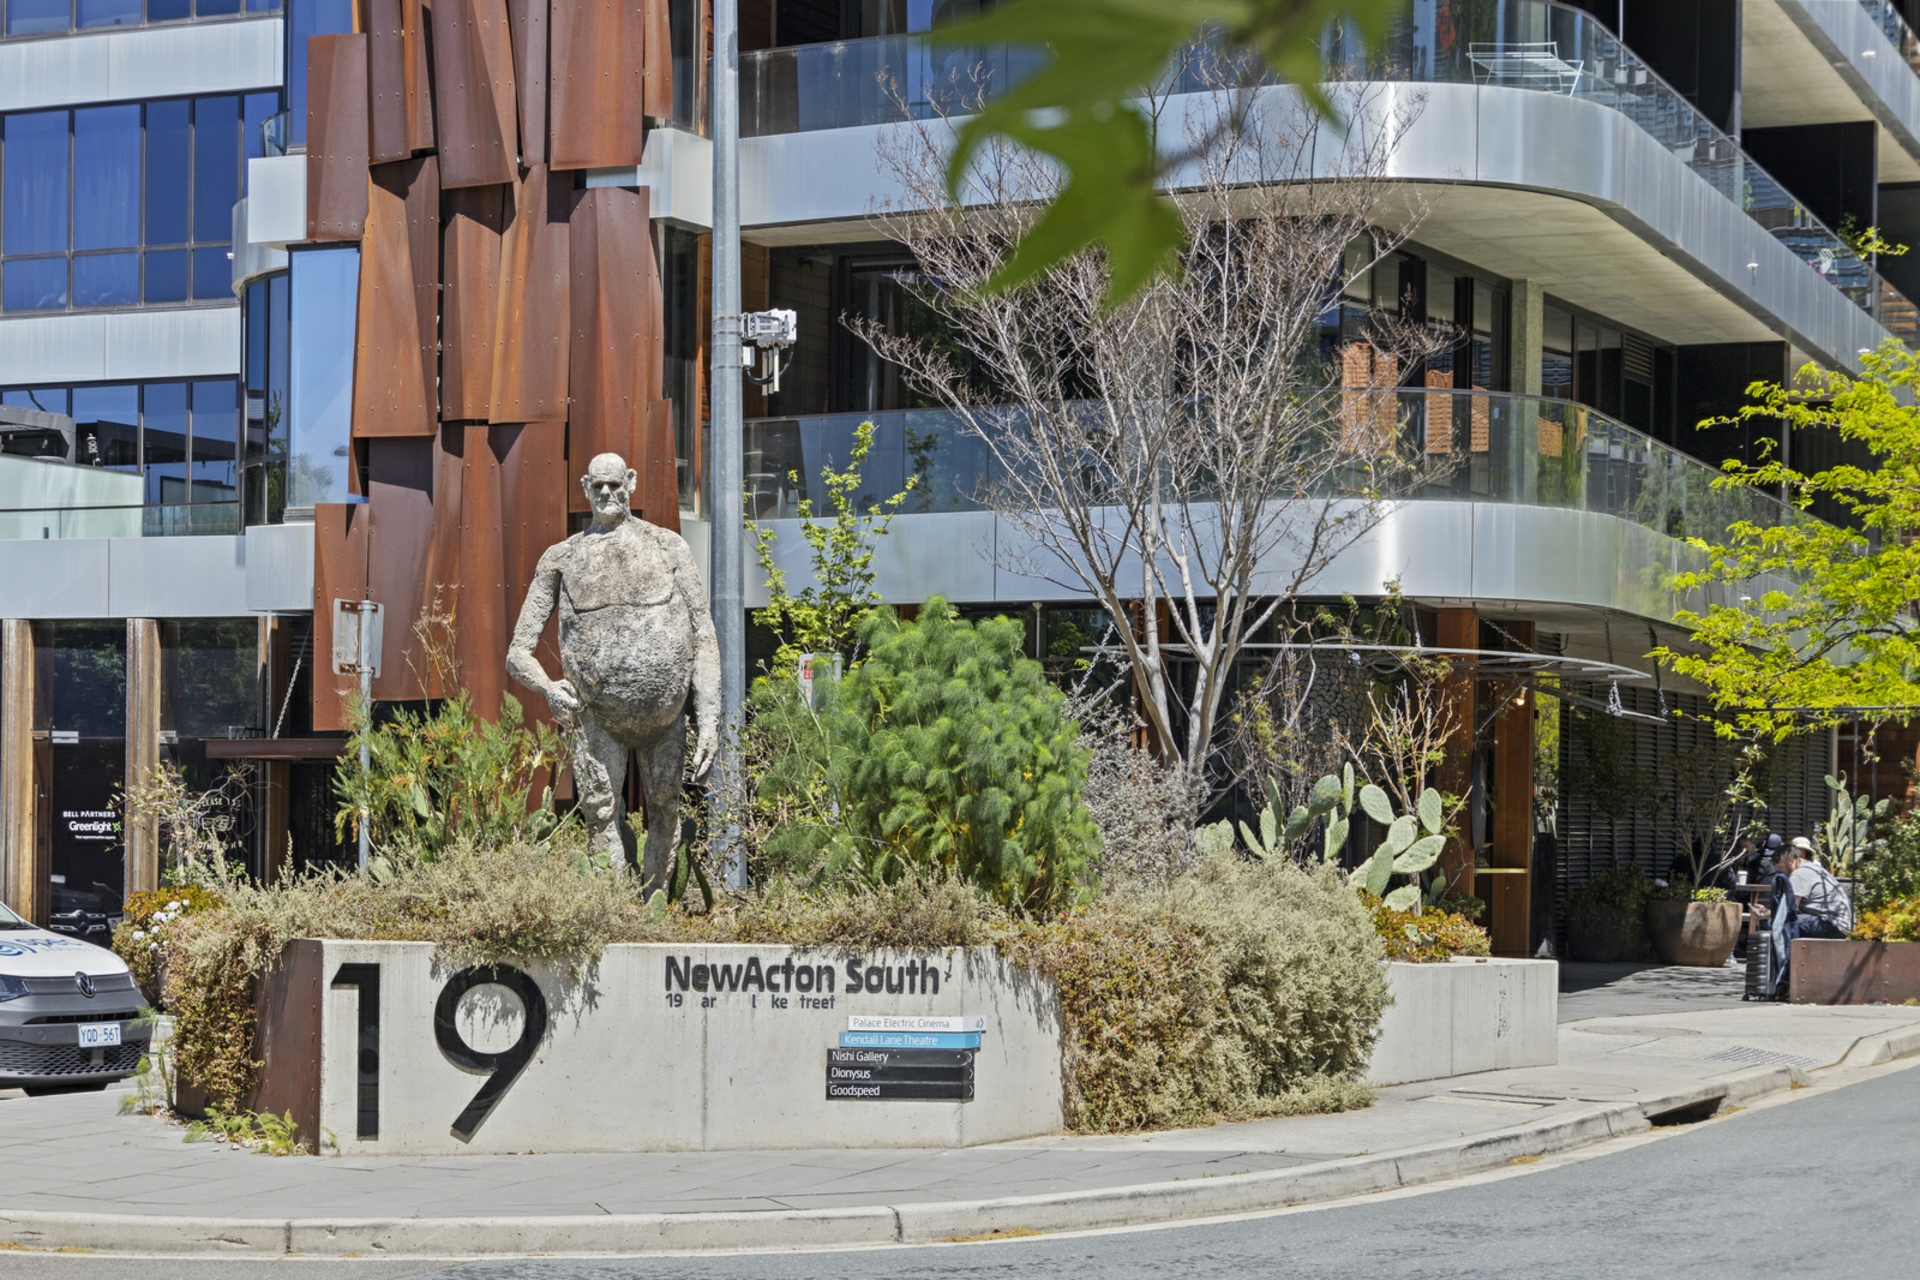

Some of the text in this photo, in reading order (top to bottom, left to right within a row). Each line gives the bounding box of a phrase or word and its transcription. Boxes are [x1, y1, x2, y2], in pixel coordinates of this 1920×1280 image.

[80, 810, 116, 818] PARTNERS
[69, 821, 112, 833] Greenlight
[665, 956, 939, 994] NewActon South
[666, 993, 683, 1008] 19
[853, 1018, 950, 1028] Palace Electric Cinema
[844, 1034, 938, 1046] Kendall Lane Theatre
[331, 963, 547, 1142] 19
[832, 1051, 889, 1063] Nishi Gallery
[831, 1067, 871, 1079] Dionysus
[829, 1085, 880, 1098] Goodspeed
